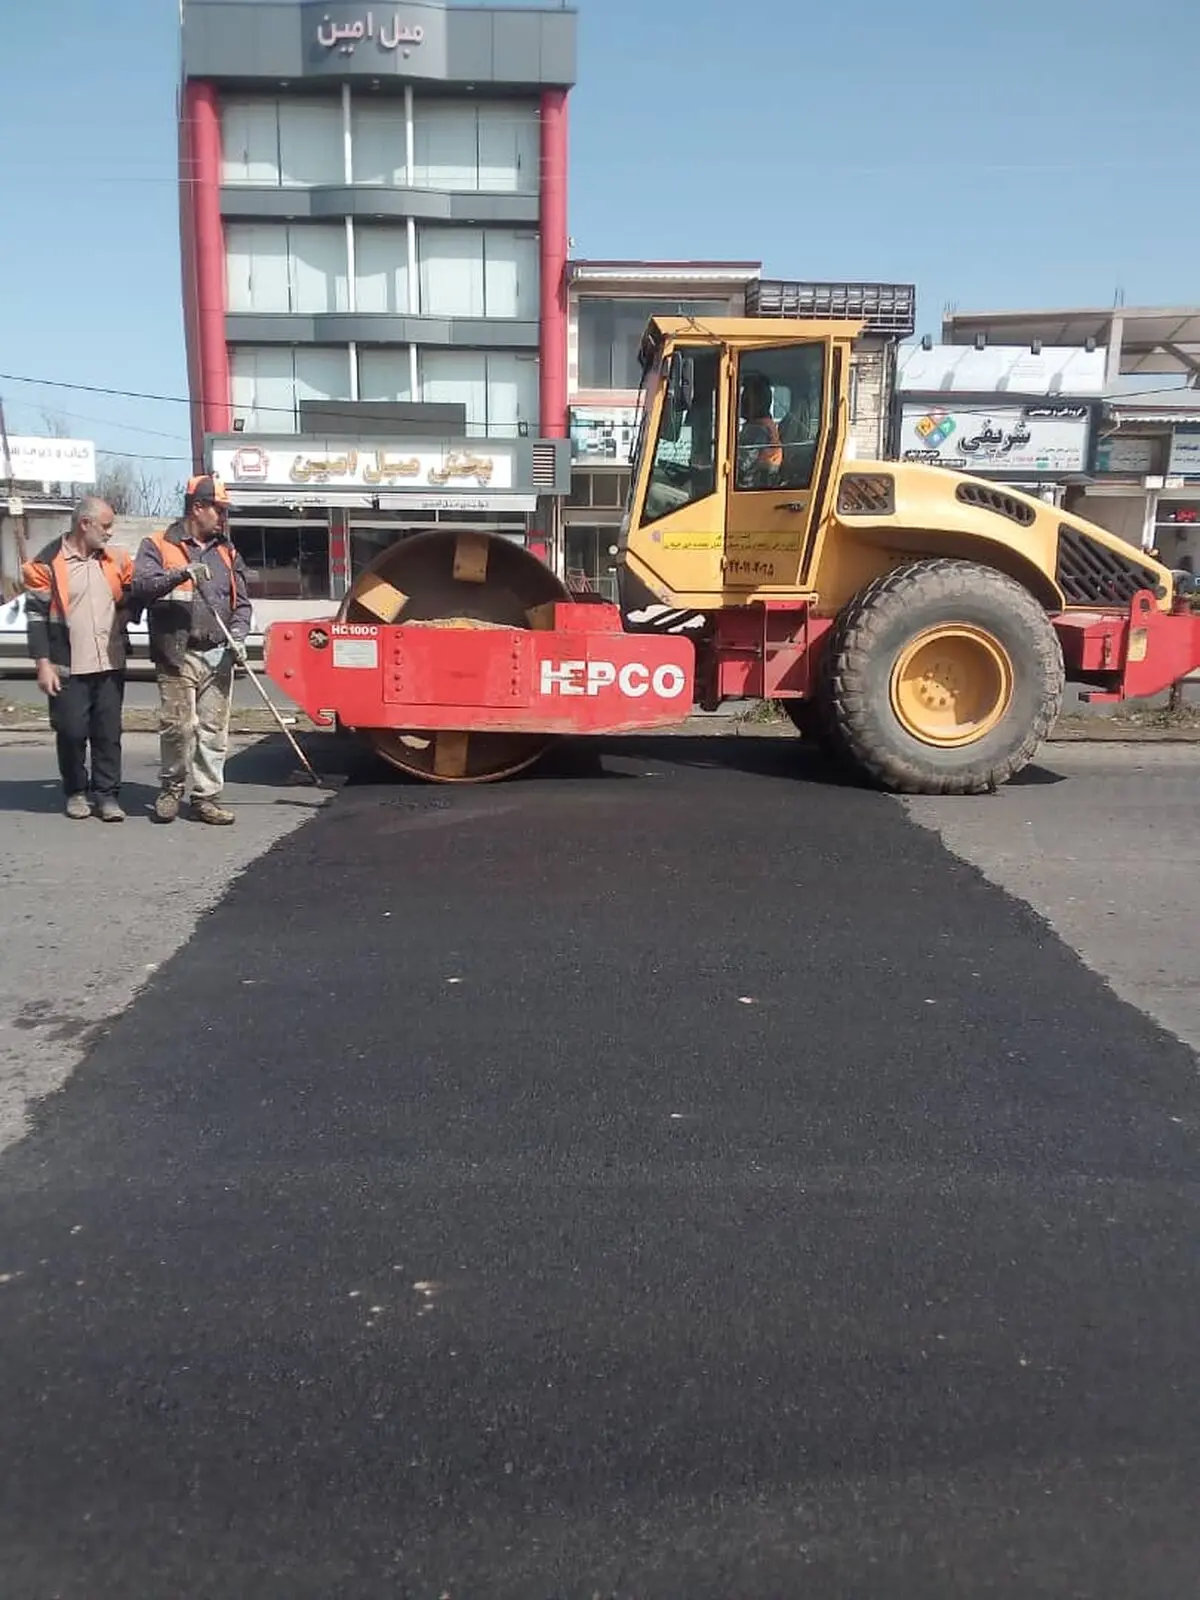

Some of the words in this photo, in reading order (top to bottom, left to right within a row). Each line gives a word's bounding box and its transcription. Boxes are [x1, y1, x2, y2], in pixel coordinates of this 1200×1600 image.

[317, 11, 373, 54] امین
[380, 11, 424, 58] مبل
[958, 418, 1032, 454] شریفی
[289, 449, 358, 483] امین
[363, 448, 421, 486] مبل
[427, 449, 494, 487] پخش
[540, 659, 686, 699] HEPCO
